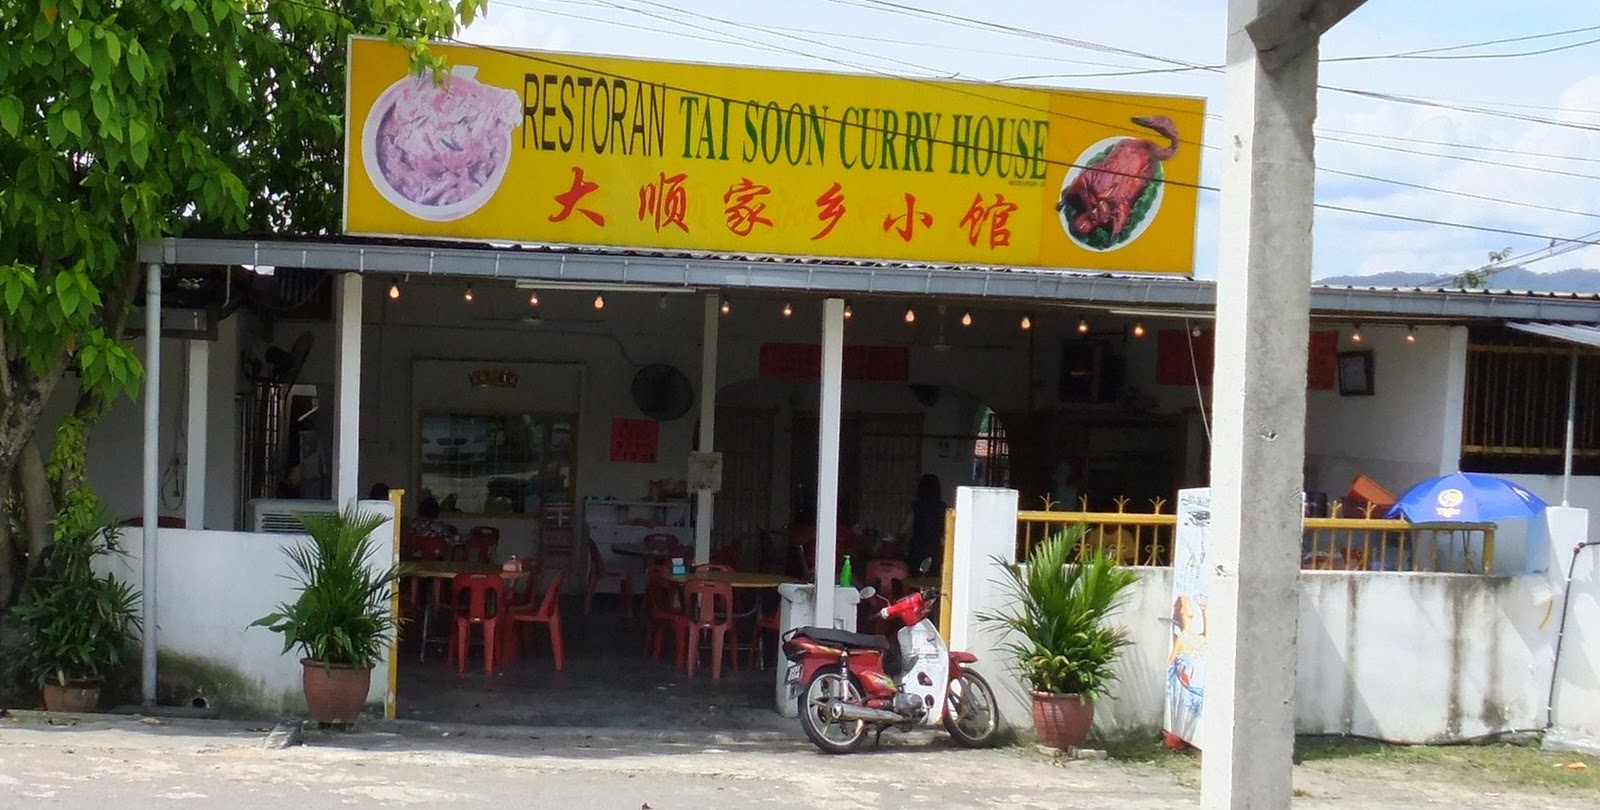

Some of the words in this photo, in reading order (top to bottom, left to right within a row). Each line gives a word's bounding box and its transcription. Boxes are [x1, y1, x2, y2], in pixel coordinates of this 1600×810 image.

[522, 73, 667, 157] RESTORAN
[680, 96, 731, 160] TAI
[743, 100, 829, 167] SOON
[839, 106, 942, 172] CURRY
[949, 114, 1049, 180] HOUSE
[547, 166, 1018, 250] 大顺家乡小馆
